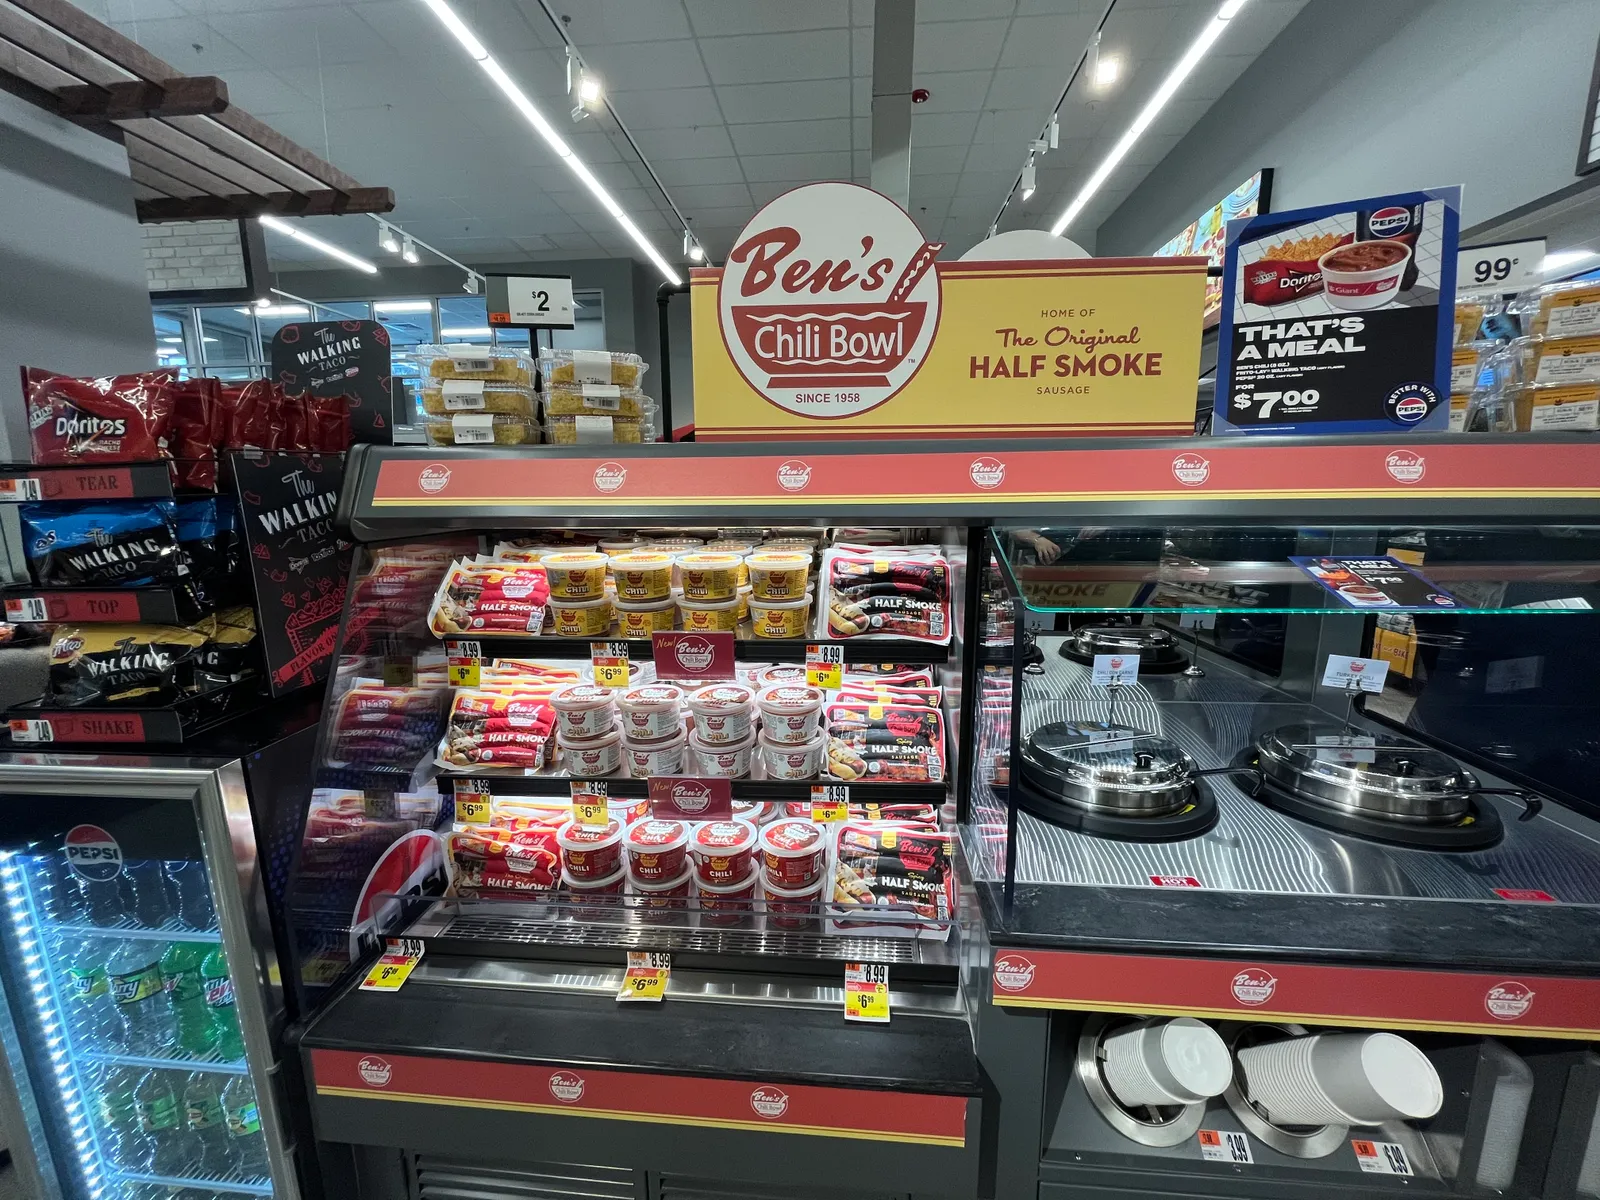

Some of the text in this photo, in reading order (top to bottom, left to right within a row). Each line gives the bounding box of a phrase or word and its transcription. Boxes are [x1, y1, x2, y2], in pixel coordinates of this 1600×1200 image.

[1372, 216, 1408, 227] PEPSI
[730, 226, 892, 297] Ben's
[1335, 286, 1359, 295] Giant
[532, 291, 550, 311] $2
[1041, 309, 1096, 318] HOME OF
[1238, 317, 1365, 342] THAT'S
[314, 328, 335, 344] The
[754, 321, 903, 359] Chili Bowl
[995, 327, 1140, 353] The Original
[297, 337, 361, 365] WALKING
[1236, 337, 1366, 360] A MEAL
[319, 356, 346, 371] TACO
[970, 352, 1163, 379] HALF SMOKE
[1036, 386, 1091, 395] SAUSAGE
[1389, 385, 1436, 404] BETTER WITH
[795, 393, 861, 404] SINCE 1958
[55, 417, 126, 436] Doritos
[1174, 459, 1200, 469] Ben's
[1386, 456, 1415, 466] Ben's
[595, 468, 619, 477] Ben's
[779, 466, 804, 475] Ben's
[972, 462, 997, 472] Ben's
[422, 469, 444, 479] Ben's
[75, 475, 118, 491] TEAR
[281, 470, 315, 497] The
[258, 490, 337, 535] WALKIN
[85, 528, 114, 547] The
[69, 538, 160, 571] WALKING
[101, 561, 137, 578] TACO
[503, 577, 529, 586] Ben's
[86, 600, 119, 615] TOP
[875, 599, 942, 611] HALF SMOKE
[114, 637, 138, 655] The
[657, 637, 676, 648] New!
[677, 642, 705, 653] Ben's
[88, 652, 169, 677] WALKING
[107, 671, 145, 685] TACO
[507, 703, 535, 713] Ben's
[886, 712, 916, 722] Ben's
[83, 720, 134, 735] SHAKE
[489, 734, 546, 743] HALF SMOK
[872, 745, 937, 755] HALF SMOKE
[653, 781, 672, 790] New!
[673, 786, 701, 796] Ben's
[513, 835, 536, 845] Ben's
[505, 847, 533, 858] Ben's
[900, 840, 930, 854] Ben's
[68, 846, 119, 860] PEPSI
[569, 864, 590, 872] CHILI
[639, 866, 662, 874] CHILI
[709, 870, 732, 878] CHILI
[907, 872, 925, 880] Spicy
[487, 878, 513, 888] HALF
[882, 876, 945, 893] HALF SMOKE
[901, 890, 929, 898] SAUSAGE
[995, 961, 1025, 973] Ben's
[1234, 974, 1267, 987] Ben's
[1489, 988, 1521, 1000] Ben's
[360, 1060, 383, 1070] Ben's
[551, 1076, 576, 1086] Ben's
[752, 1091, 780, 1102] Ben's
